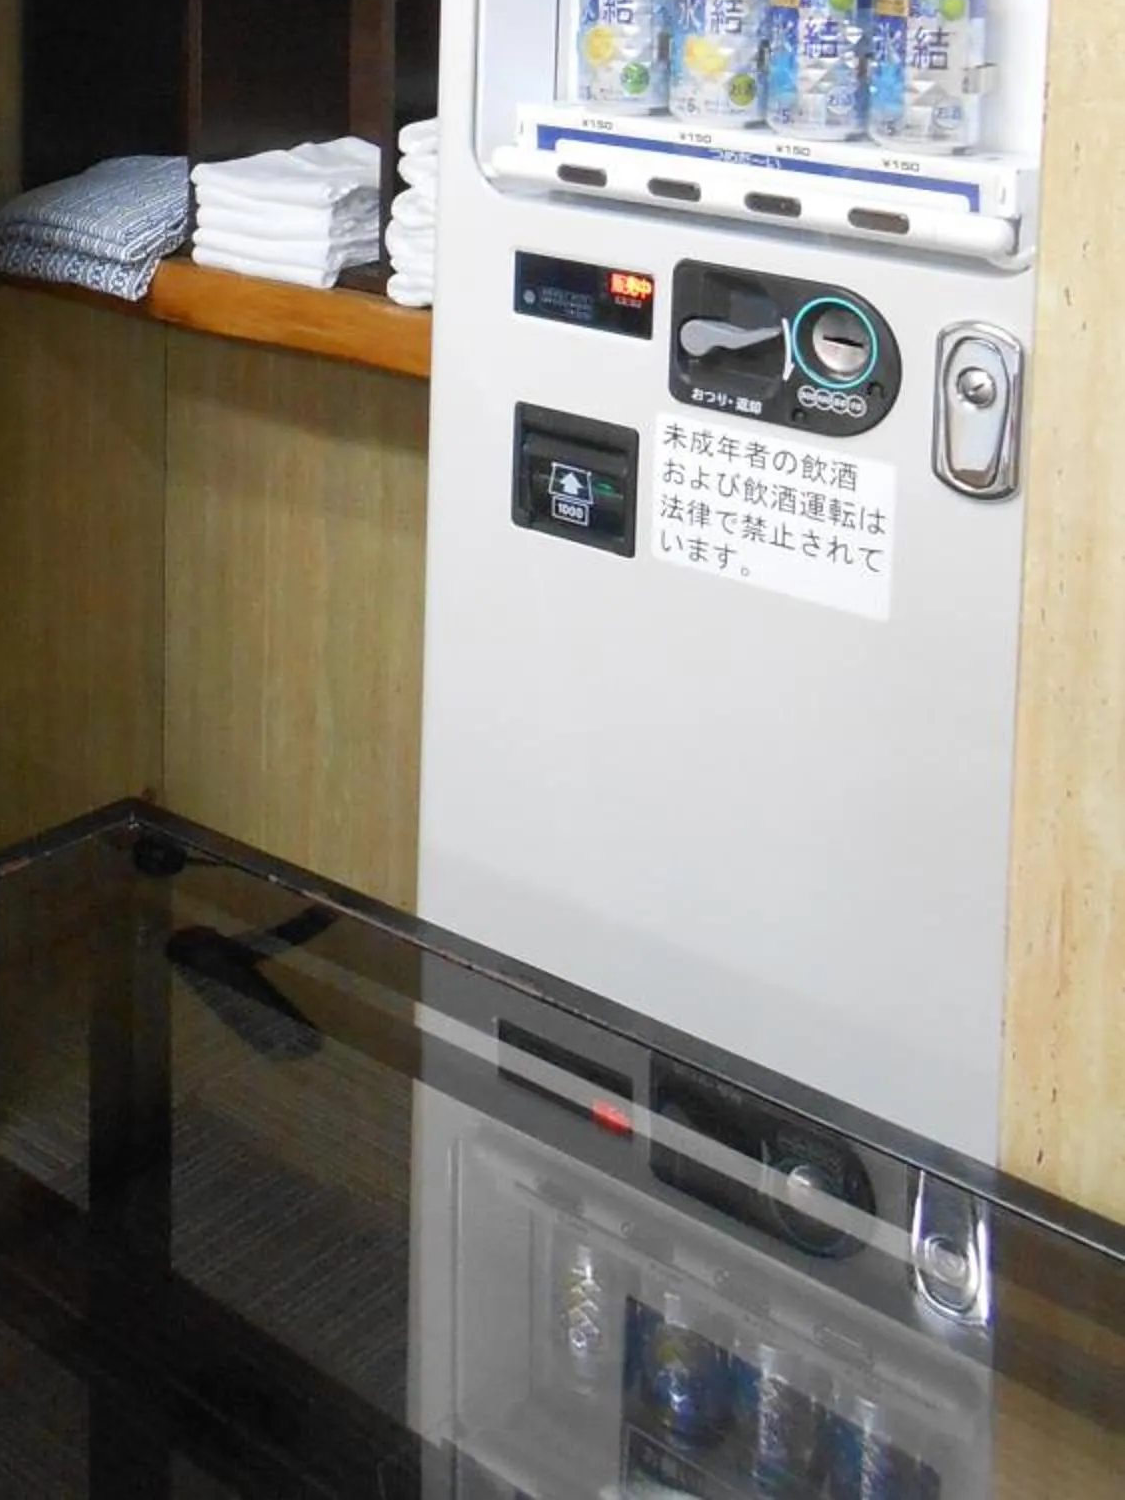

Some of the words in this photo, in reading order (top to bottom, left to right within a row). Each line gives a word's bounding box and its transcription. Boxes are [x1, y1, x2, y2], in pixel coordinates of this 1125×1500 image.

[662, 422, 859, 492] 未成年者の飲酒
[662, 458, 887, 535] および飲酒運転は
[660, 494, 885, 573] 法律で禁止されて
[660, 530, 751, 577] います。
